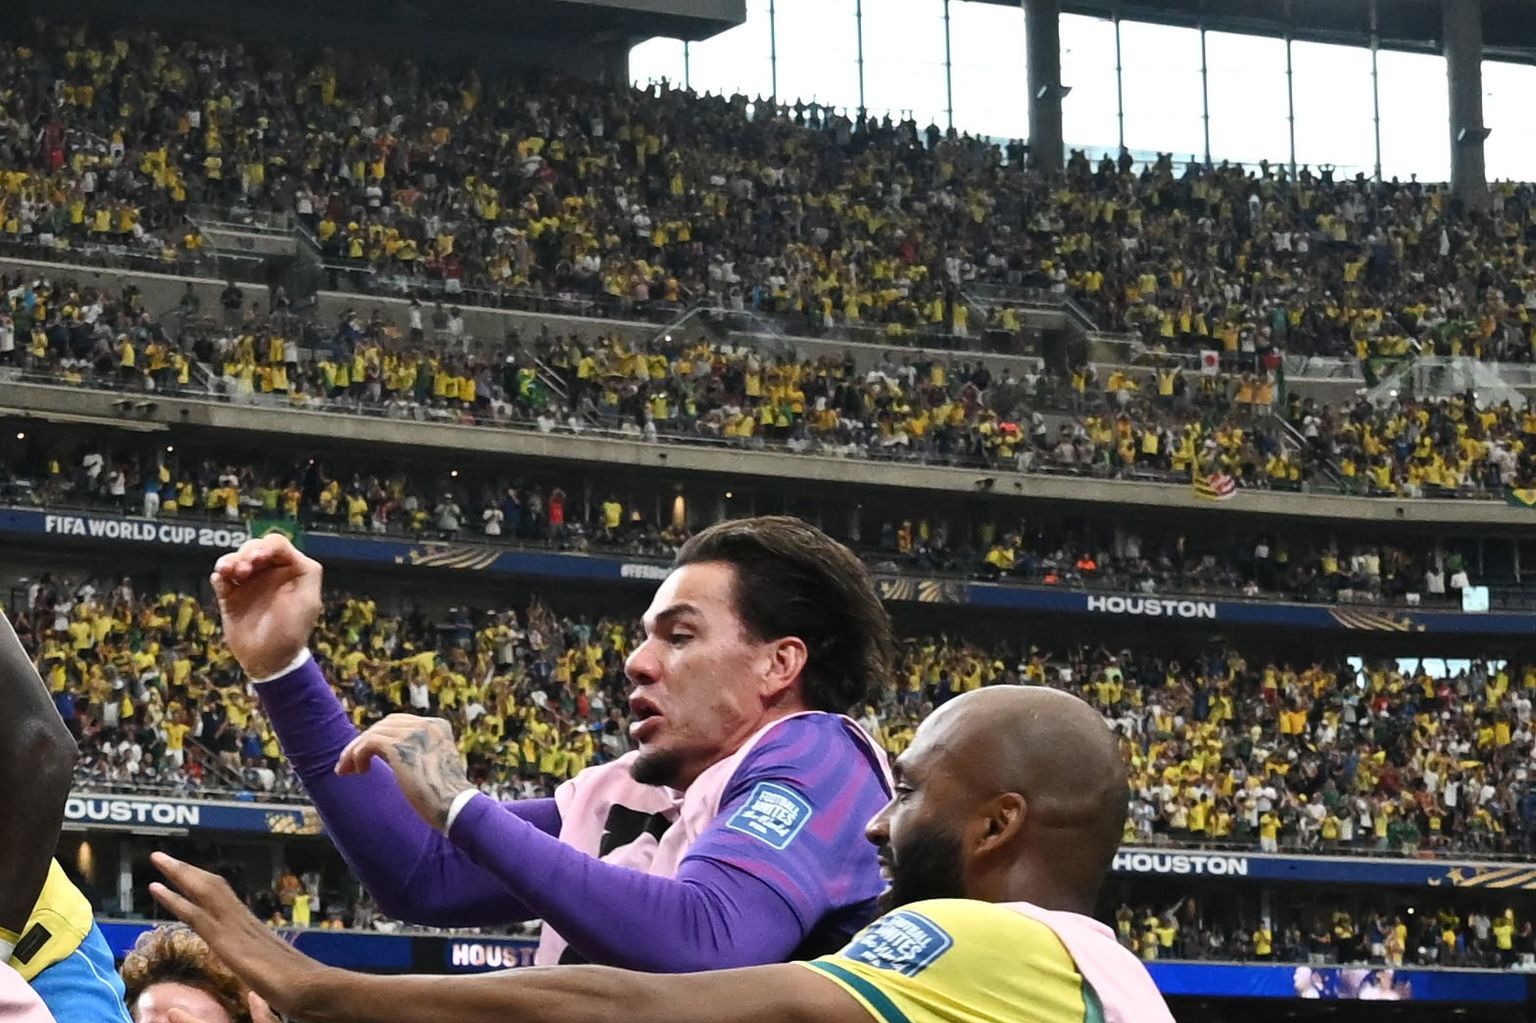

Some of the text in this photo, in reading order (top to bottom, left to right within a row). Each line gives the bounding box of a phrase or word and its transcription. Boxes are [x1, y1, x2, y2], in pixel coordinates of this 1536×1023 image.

[45, 515, 246, 548] FIFA WORLD CUP 202
[1087, 595, 1216, 619] HOUSTON
[64, 799, 199, 825] OUSTON
[1112, 853, 1248, 876] HOUSTON
[452, 943, 536, 968] HOUST
